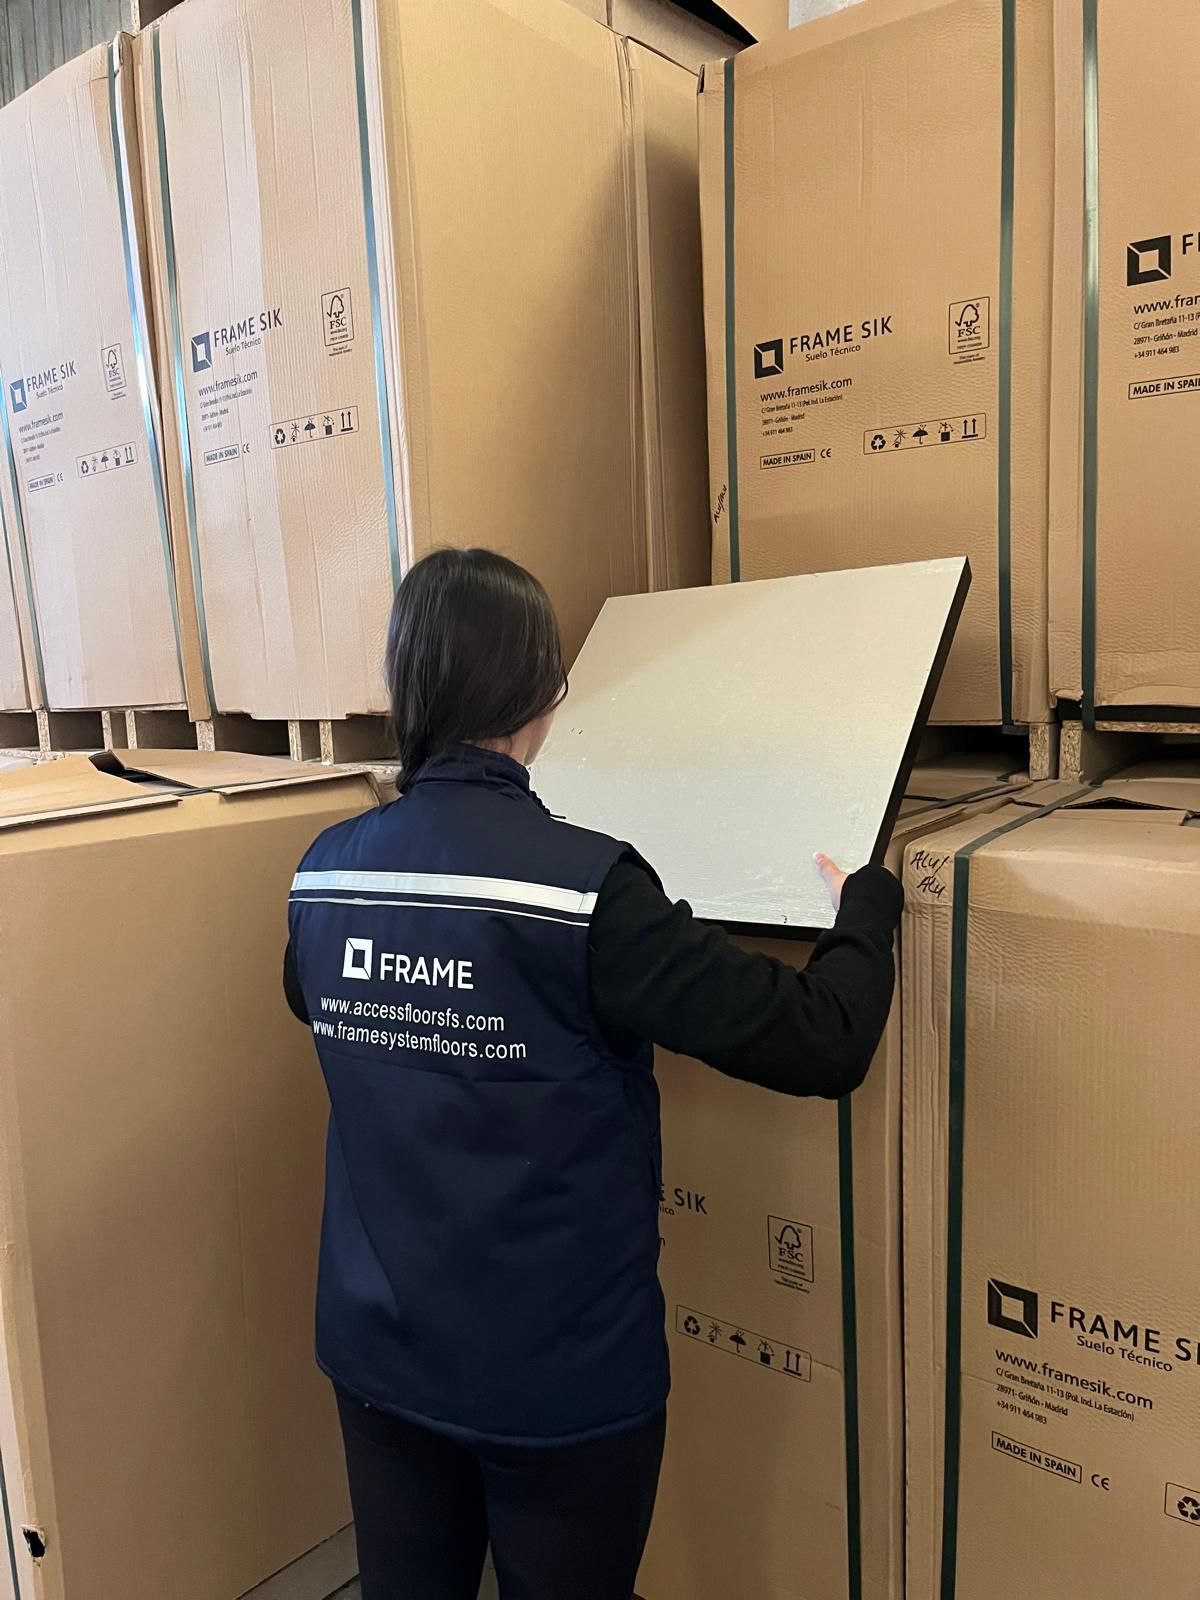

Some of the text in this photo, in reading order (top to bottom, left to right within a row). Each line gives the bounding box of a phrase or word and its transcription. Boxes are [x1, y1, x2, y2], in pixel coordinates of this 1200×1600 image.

[1182, 232, 1200, 255] F
[213, 308, 283, 348] FRAME SIK
[329, 316, 347, 330] FSC
[789, 315, 893, 354] FRAME SIK
[957, 325, 981, 338] FSC
[1177, 328, 1198, 338] Madrid
[225, 337, 262, 356] Suelo Técnico
[805, 343, 861, 363] Suelo Técnico
[27, 360, 77, 392] FRAME SIK
[198, 370, 258, 397] www.framesik.com
[1133, 383, 1161, 396] MADE
[1163, 381, 1175, 391] IN
[760, 378, 853, 403] www.framesik.com
[206, 448, 238, 463] MADE IN SPAIN
[762, 451, 812, 467] MADE IN SPAIN
[380, 952, 474, 990] FRAME
[320, 996, 505, 1032] www.accessfloorsfs.com
[312, 1019, 527, 1060] www.framesystemfloors.com
[674, 1187, 708, 1215] SIK
[778, 1246, 804, 1263] FSC
[1050, 1300, 1161, 1354] FRAME
[1076, 1335, 1173, 1372] Suelo Técnico
[995, 1349, 1153, 1410] www.framesik.com
[1004, 1370, 1020, 1382] Gran
[1046, 1384, 1065, 1398] 11-13
[1094, 1401, 1103, 1411] La
[1009, 1404, 1021, 1415] 911
[1045, 1401, 1068, 1417] Madrid
[996, 1437, 1077, 1479] MADE IN SPAIN
